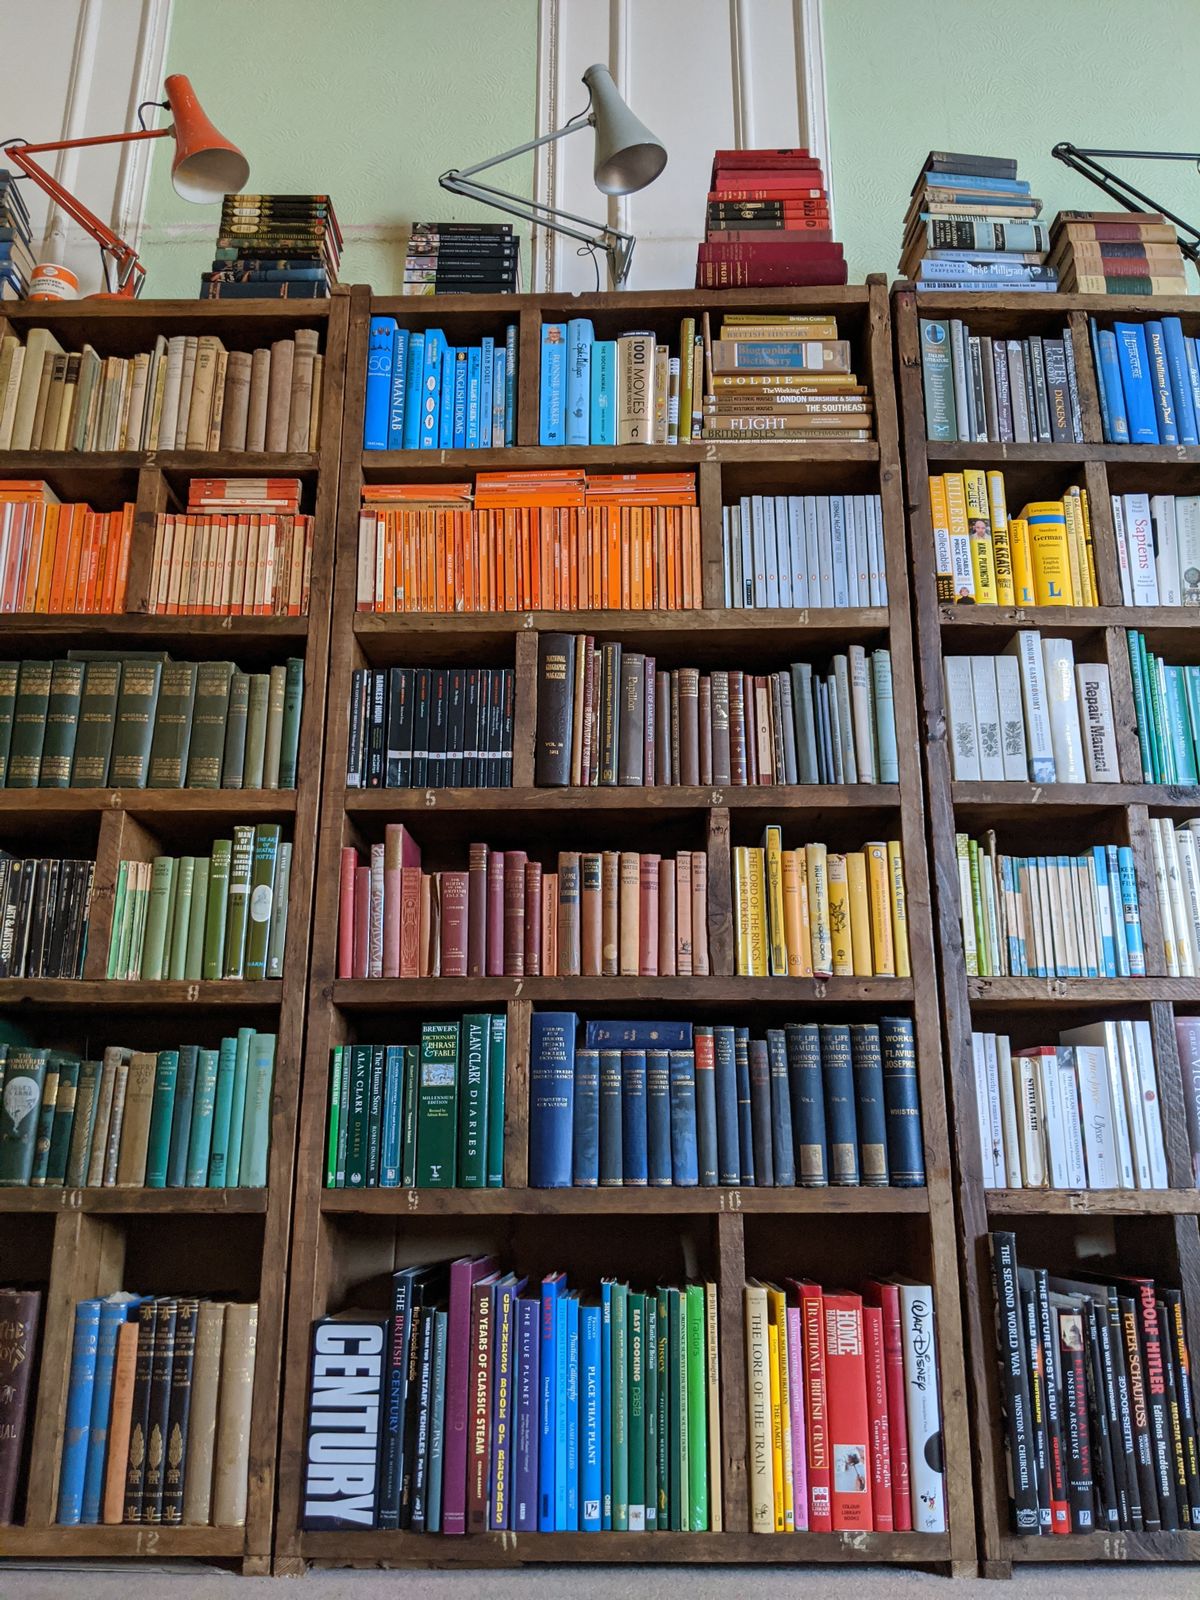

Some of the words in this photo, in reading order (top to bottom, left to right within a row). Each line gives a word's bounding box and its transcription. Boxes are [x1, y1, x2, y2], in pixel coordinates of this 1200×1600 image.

[967, 264, 988, 276] Spike
[991, 265, 1023, 276] Milligan
[634, 340, 644, 364] 1001
[739, 344, 802, 355] Biographical
[739, 355, 791, 366] Dictionary
[1044, 348, 1056, 384] ACKROYD
[1053, 347, 1067, 385] PETER
[394, 378, 404, 406] MAN
[633, 368, 645, 414] MOVIES
[392, 408, 402, 430] LAB
[455, 402, 464, 434] IDIOMS
[731, 418, 787, 430] FLIGHT
[1054, 389, 1066, 428] DICKENS
[708, 430, 749, 438] BRITISH
[751, 430, 776, 438] ISLES
[706, 445, 716, 459] 2
[947, 476, 965, 533] MILLER'S
[937, 530, 948, 572] collectables
[994, 530, 1007, 545] THE
[1132, 519, 1148, 568] Sapiens
[961, 539, 970, 576] COLLECTABLES
[979, 559, 989, 587] PILKINGTON
[995, 547, 1010, 575] KRAYS
[1048, 582, 1062, 597] L
[1026, 635, 1036, 666] ECONOMY
[375, 674, 384, 702] DARKEST
[628, 677, 638, 711] Papillon
[1030, 668, 1040, 710] GASTRONOMY
[1085, 681, 1099, 720] Repair
[374, 703, 383, 724] HOUR
[1090, 725, 1110, 772] Manual
[111, 792, 122, 808] 6
[425, 790, 436, 806] 5
[1032, 787, 1042, 802] 7
[749, 851, 757, 865] THE
[750, 867, 758, 893] LORD
[751, 894, 759, 910] OF
[752, 930, 760, 961] RINGS
[188, 985, 200, 1001] 8
[514, 979, 524, 997] 7
[424, 1046, 434, 1057] &
[470, 1024, 482, 1049] ALAN
[357, 1051, 365, 1076] ALAN
[468, 1051, 480, 1084] CLARK
[355, 1079, 364, 1113] CLARK
[373, 1070, 382, 1096] Human
[371, 1097, 381, 1116] Story
[469, 1090, 478, 1155] DIARIES
[61, 1191, 82, 1208] 10
[1000, 1244, 1011, 1265] THE
[396, 1286, 406, 1311] THE
[1003, 1268, 1015, 1308] SECOND
[752, 1313, 761, 1339] THE
[1041, 1301, 1051, 1349] PICTURE
[1140, 1287, 1158, 1336] ADOLF
[392, 1315, 404, 1366] BRITISH
[501, 1294, 510, 1373] GUINNESS
[807, 1302, 820, 1374] TRADITIONAL
[837, 1309, 858, 1355] HOME
[1007, 1310, 1018, 1348] WORLD
[1124, 1313, 1137, 1352] PETER
[752, 1343, 762, 1377] LORE
[1010, 1351, 1021, 1376] WAR
[1045, 1351, 1054, 1378] POST
[1146, 1342, 1165, 1394] HITLER
[389, 1370, 401, 1433] CENTURY
[499, 1378, 507, 1419] BOOK
[632, 1387, 640, 1417] pasta
[754, 1381, 764, 1398] OF
[811, 1378, 823, 1420] BRITISH
[1047, 1380, 1057, 1420] ALBUM
[1129, 1354, 1146, 1427] SCHAUFUSS
[305, 1324, 384, 1526] CENTURY
[754, 1402, 764, 1429] THE
[1118, 1376, 1134, 1454] VILLERS-BOCAGE
[498, 1424, 505, 1444] OF
[813, 1425, 824, 1466] CRAFTS
[755, 1434, 766, 1475] TRAIN
[496, 1450, 505, 1523] RECORDS
